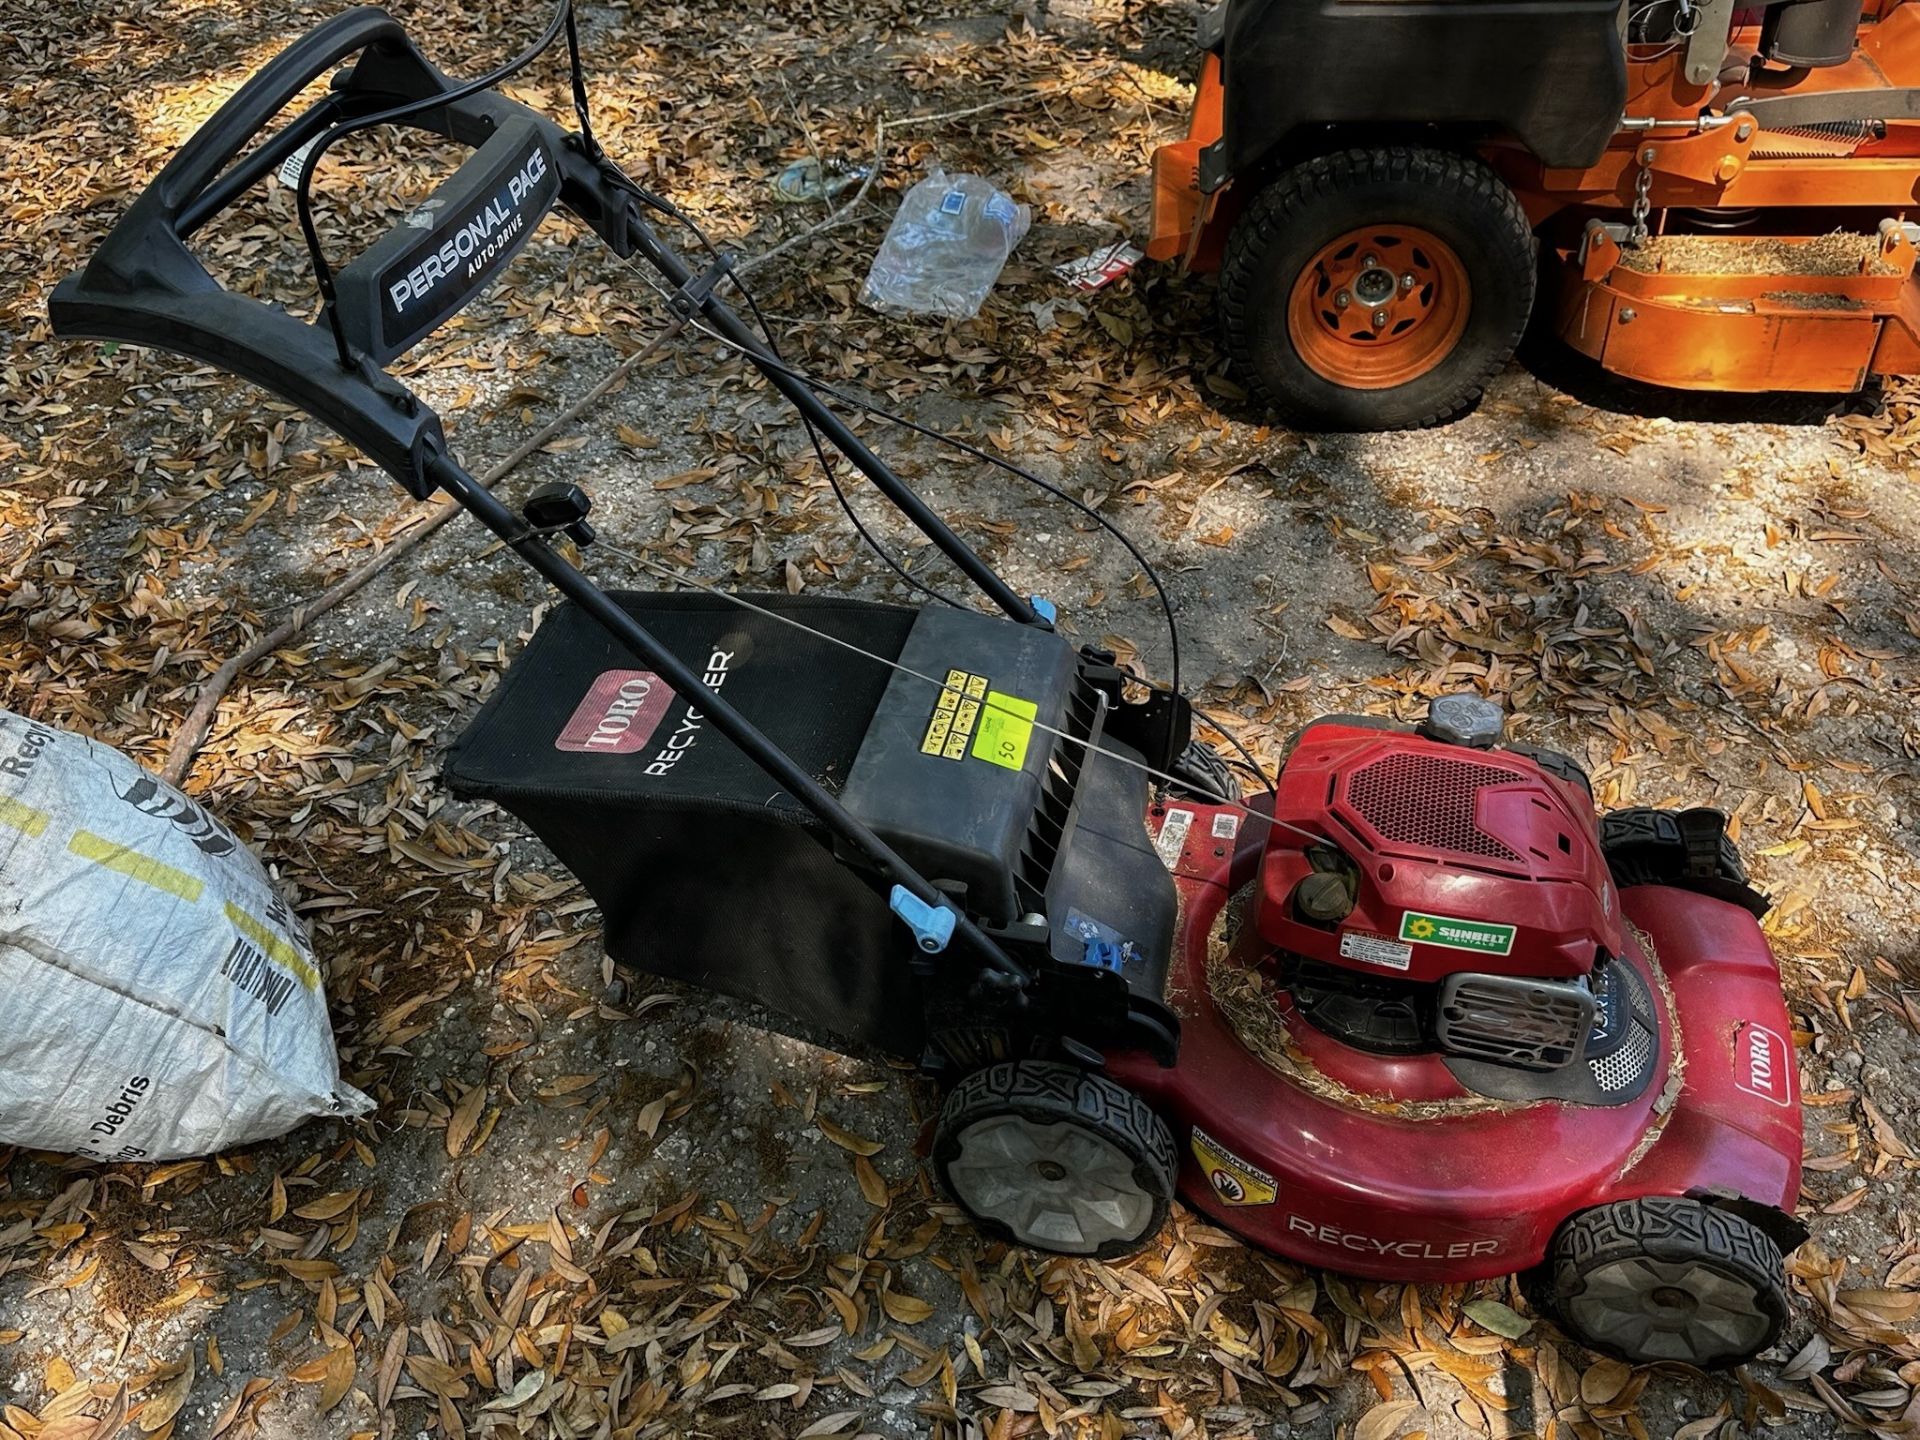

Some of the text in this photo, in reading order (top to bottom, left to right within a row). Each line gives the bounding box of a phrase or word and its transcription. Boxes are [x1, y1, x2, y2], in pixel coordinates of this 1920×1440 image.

[390, 148, 547, 313] PERSONAL PACE
[468, 213, 523, 278] AUTO-DRIVE
[584, 679, 650, 748] TORO
[643, 651, 735, 777] RECYCER
[999, 741, 1015, 760] 50
[1438, 926, 1507, 944] SUNBELT
[1749, 1030, 1772, 1092] TORO
[90, 1076, 150, 1136] Debris
[1288, 1214, 1500, 1260] RECYCLER
